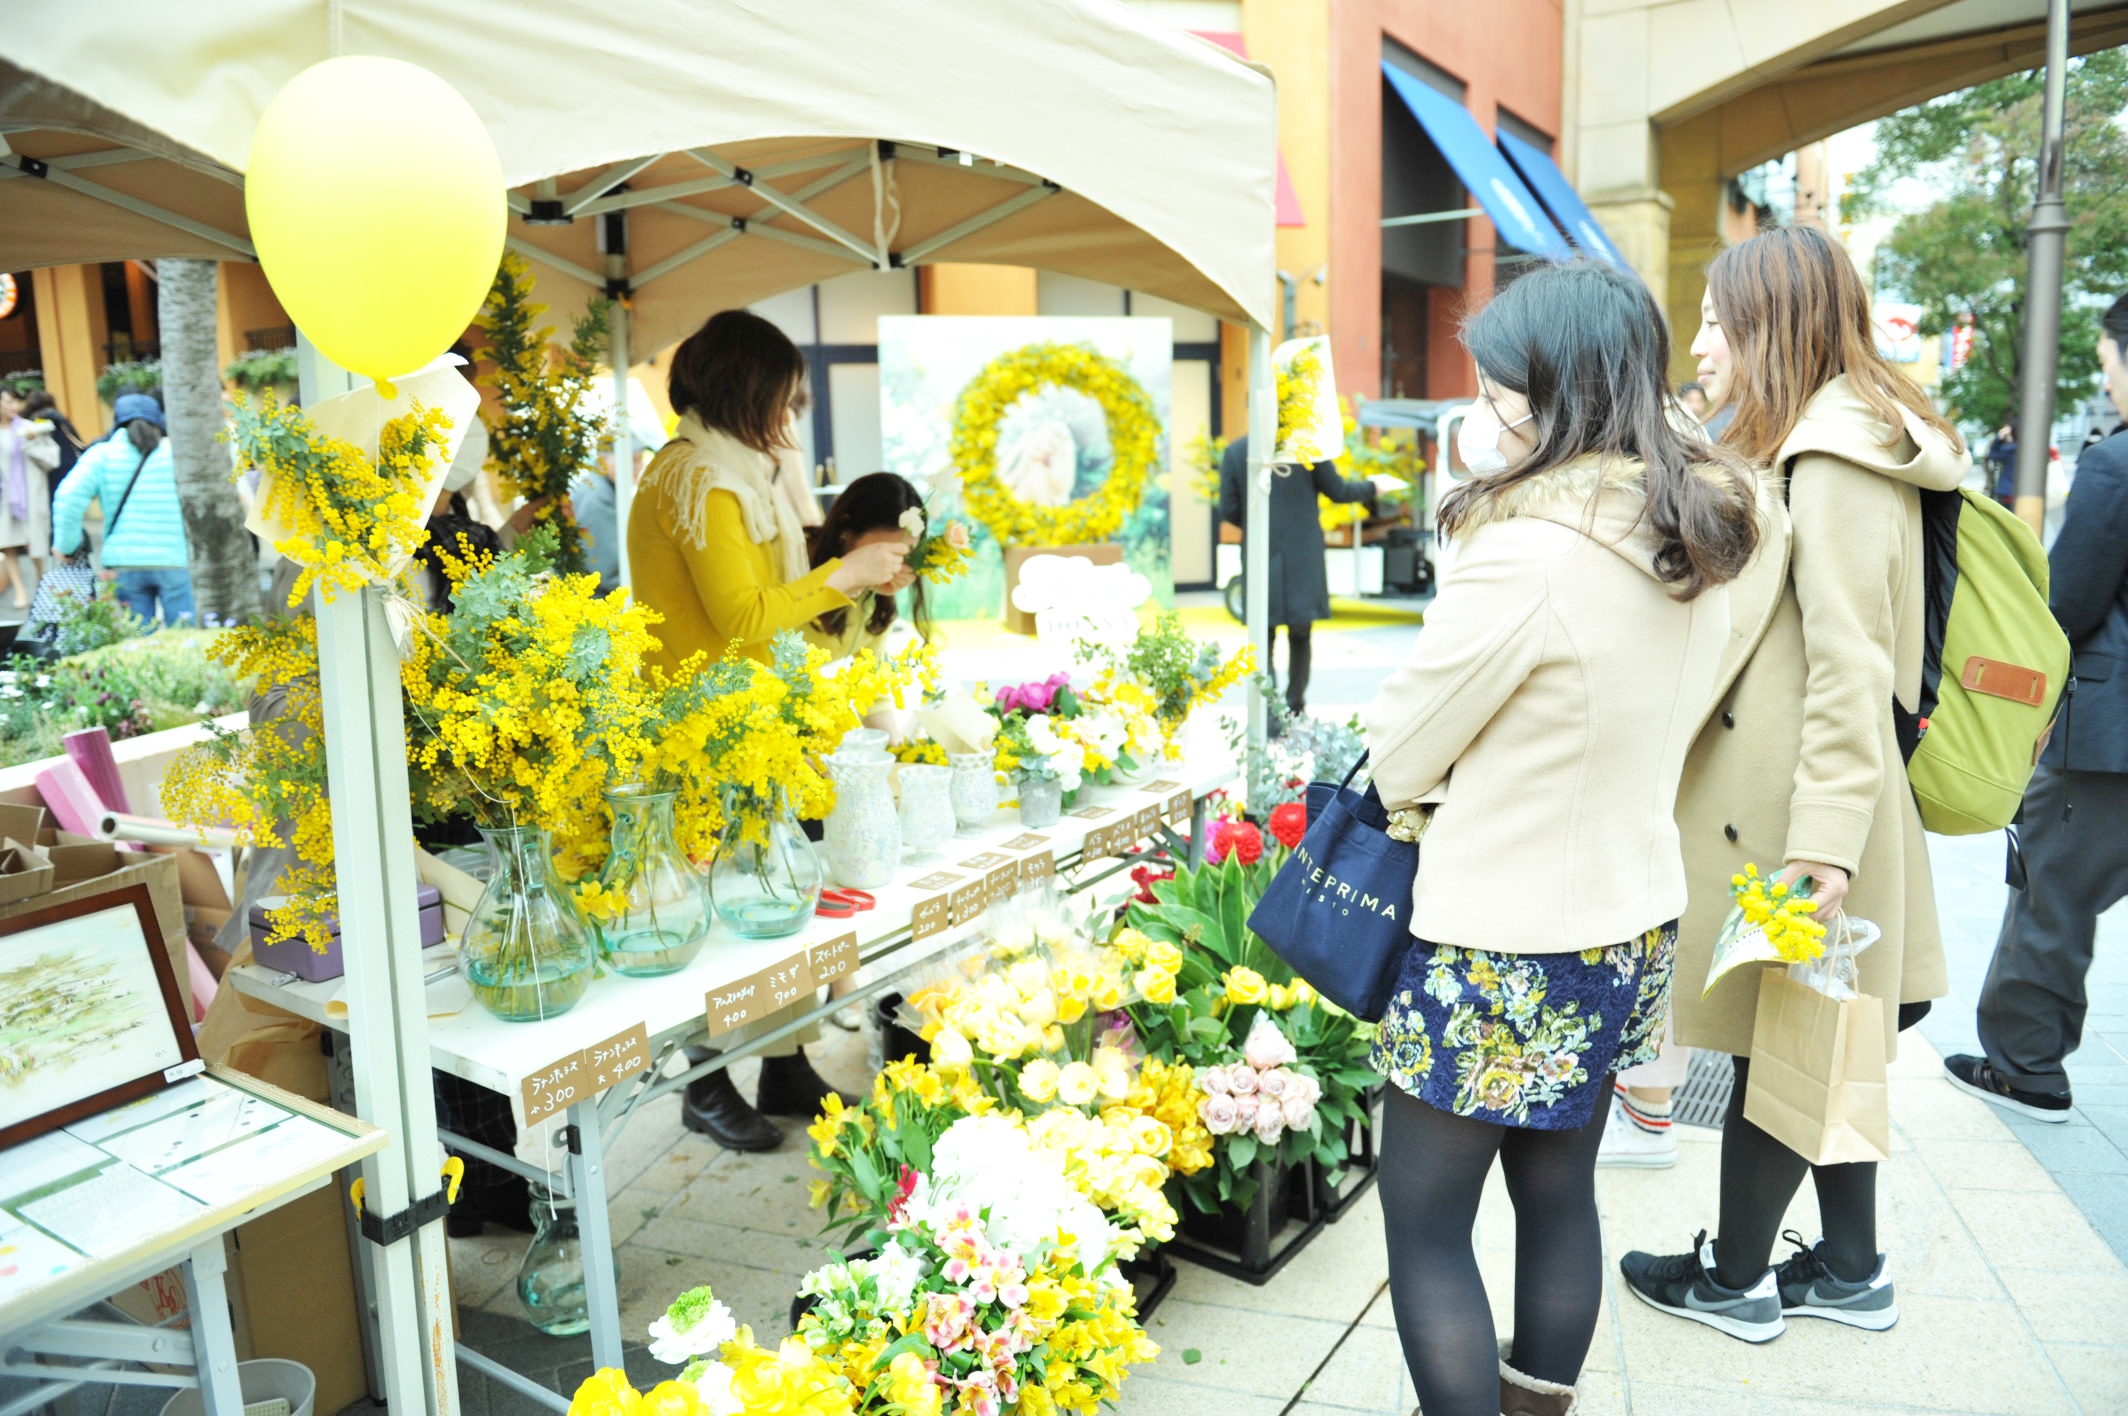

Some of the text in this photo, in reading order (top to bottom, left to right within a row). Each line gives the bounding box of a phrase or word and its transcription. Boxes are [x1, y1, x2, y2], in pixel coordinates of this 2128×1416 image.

[769, 963, 800, 988] ミモザ
[819, 960, 847, 981] 200
[723, 1009, 747, 1028] 400
[593, 1037, 638, 1067] ラナンキュラス
[531, 1061, 579, 1096] ラナンキュラス
[612, 1055, 642, 1080] 400
[543, 1086, 576, 1112] 300
